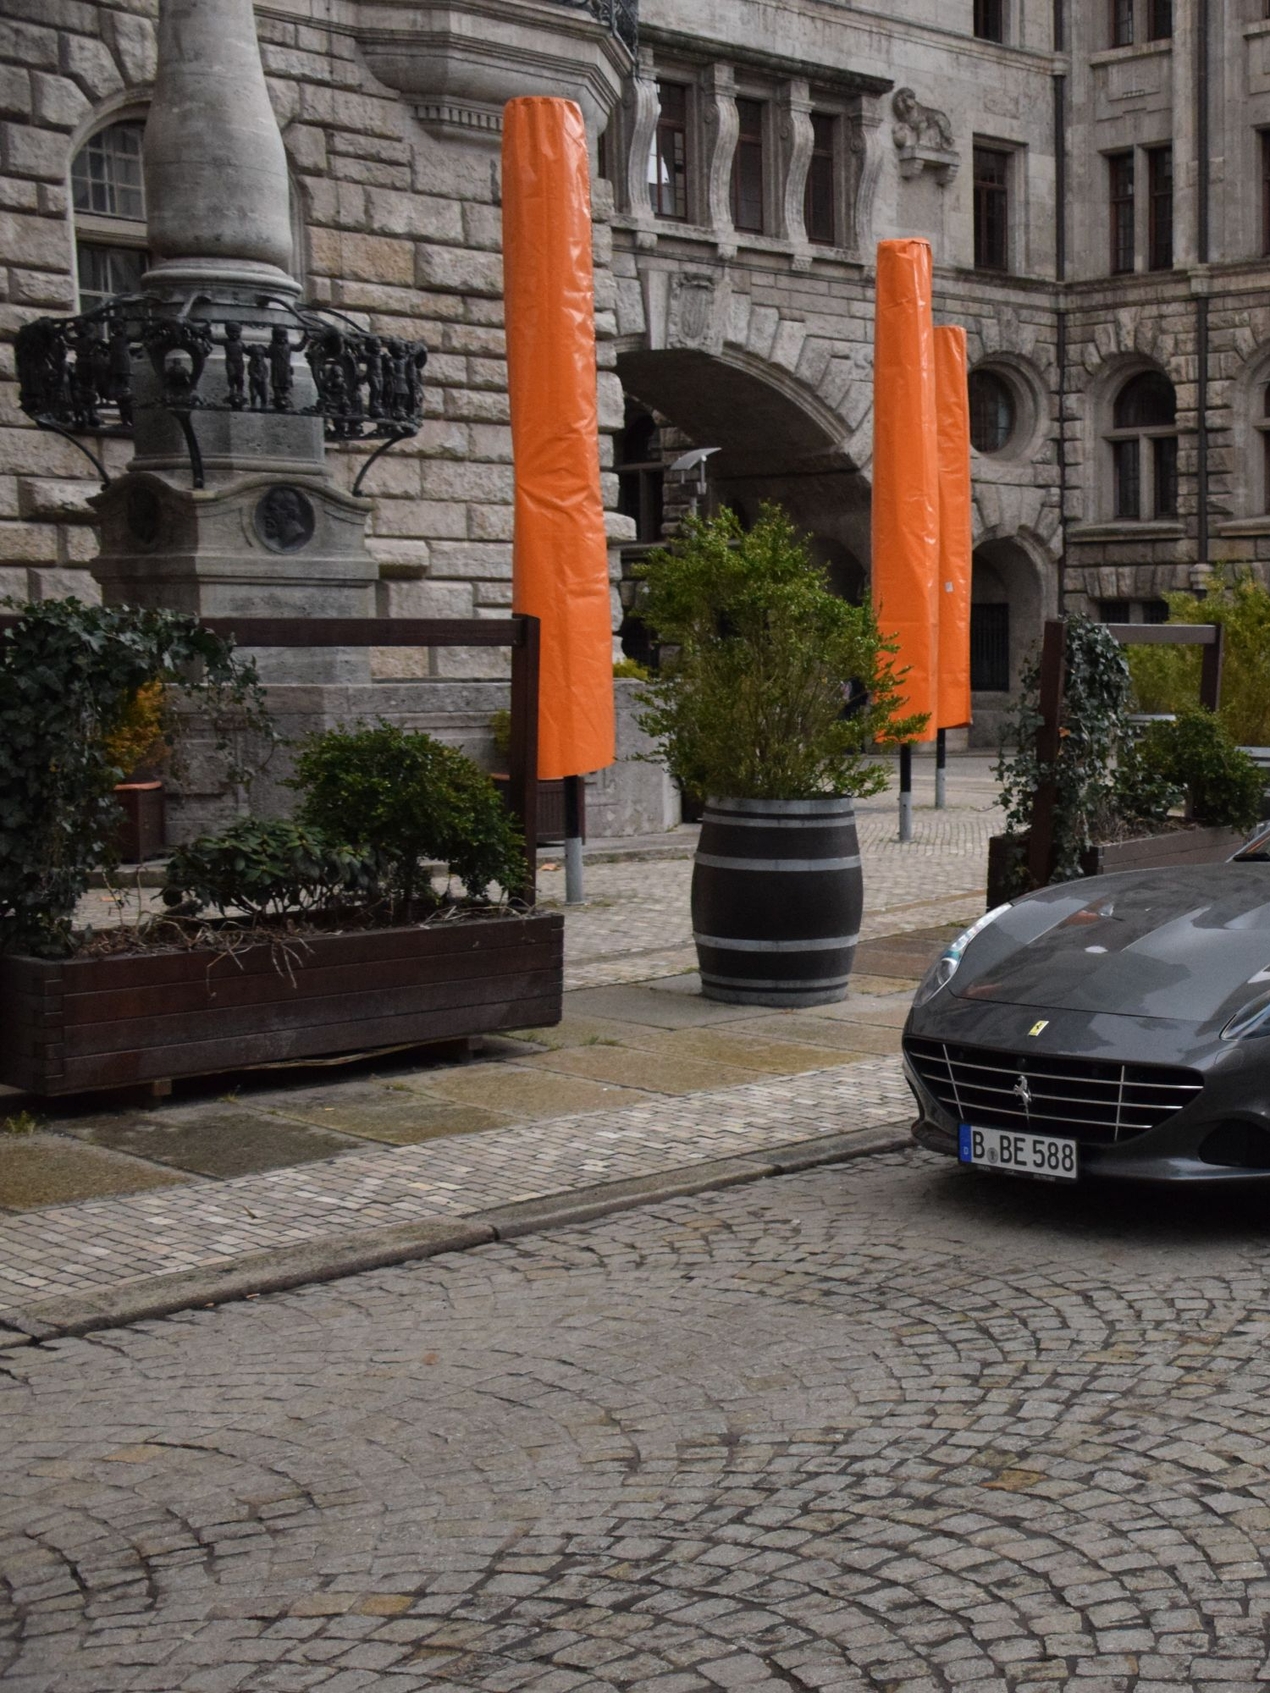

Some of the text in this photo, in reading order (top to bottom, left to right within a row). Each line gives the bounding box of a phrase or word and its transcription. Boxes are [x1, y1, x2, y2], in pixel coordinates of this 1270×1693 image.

[972, 1130, 985, 1159] B
[1000, 1135, 1028, 1167] BE
[1032, 1139, 1075, 1173] 588
